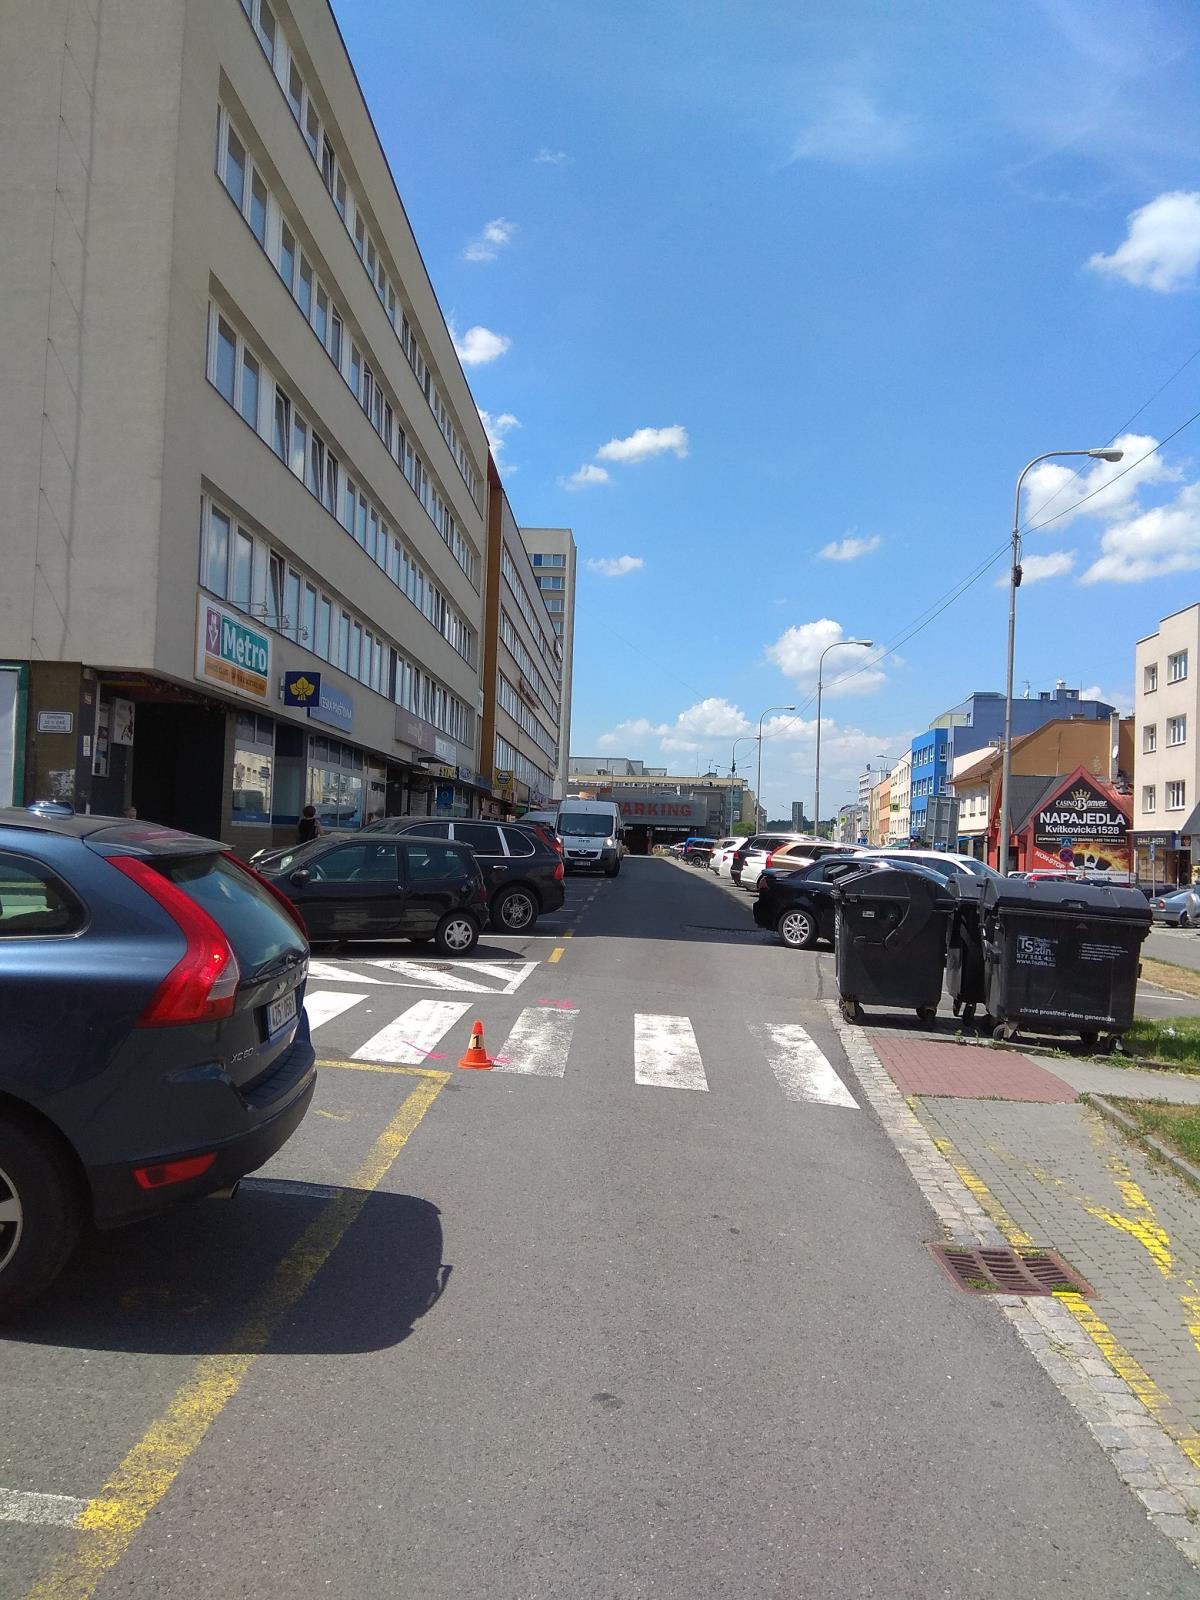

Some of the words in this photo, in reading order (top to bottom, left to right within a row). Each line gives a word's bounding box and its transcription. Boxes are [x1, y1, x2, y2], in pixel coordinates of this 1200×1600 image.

[223, 622, 267, 672] Metro
[621, 802, 692, 816] ARKING
[1040, 812, 1126, 825] NAPAJEDLA
[1045, 825, 1097, 834] Kvítkovická
[1097, 826, 1120, 834] 1528
[1035, 850, 1065, 869] NON-STOP
[1019, 937, 1034, 952] TS
[472, 1035, 482, 1049] 1
[231, 1047, 254, 1064] XC60
